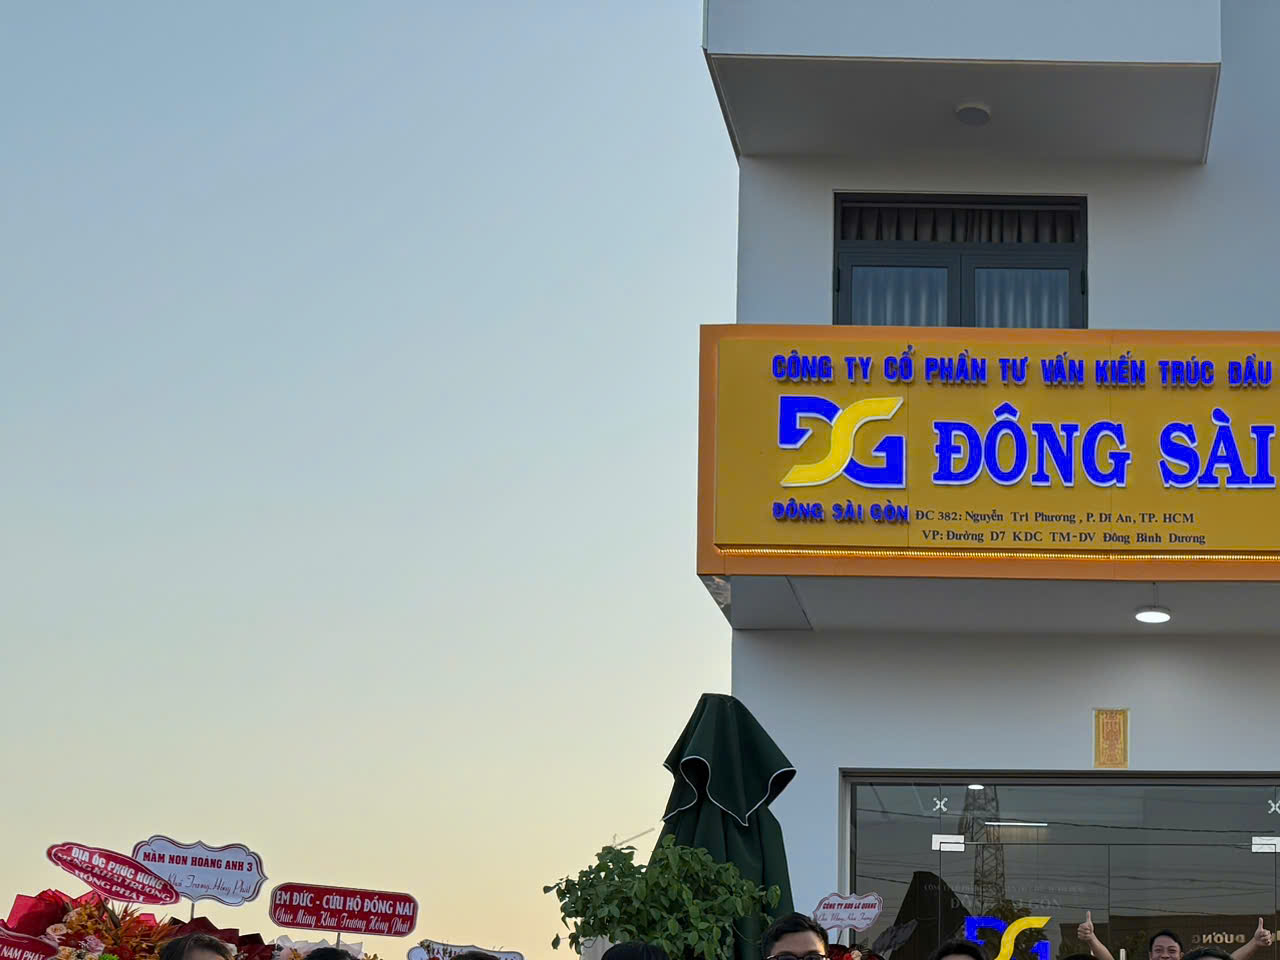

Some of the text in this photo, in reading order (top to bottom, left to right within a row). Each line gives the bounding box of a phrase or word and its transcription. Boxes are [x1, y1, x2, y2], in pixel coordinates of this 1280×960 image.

[772, 349, 833, 382] CÔNG
[844, 356, 873, 383] TY
[884, 344, 916, 383] CỔ
[925, 349, 988, 384] PHẦN
[998, 356, 1030, 385] TƯ
[1040, 351, 1085, 386] VẤN
[1095, 351, 1146, 386] KIẾN
[1158, 355, 1215, 387] TRÚC
[1227, 353, 1272, 388] ĐẦU
[931, 401, 1132, 489] ĐÔNG
[1158, 407, 1277, 489] SÀI
[772, 497, 910, 523] ĐÔNG SÀI GÒN
[1163, 513, 1195, 523] HCM
[1013, 531, 1043, 542] KDC
[168, 854, 188, 866] NON
[224, 859, 245, 872] ANH
[246, 861, 253, 872] 3
[275, 891, 290, 905] EM
[395, 901, 415, 916] NAI
[1, 945, 22, 960] NAM
